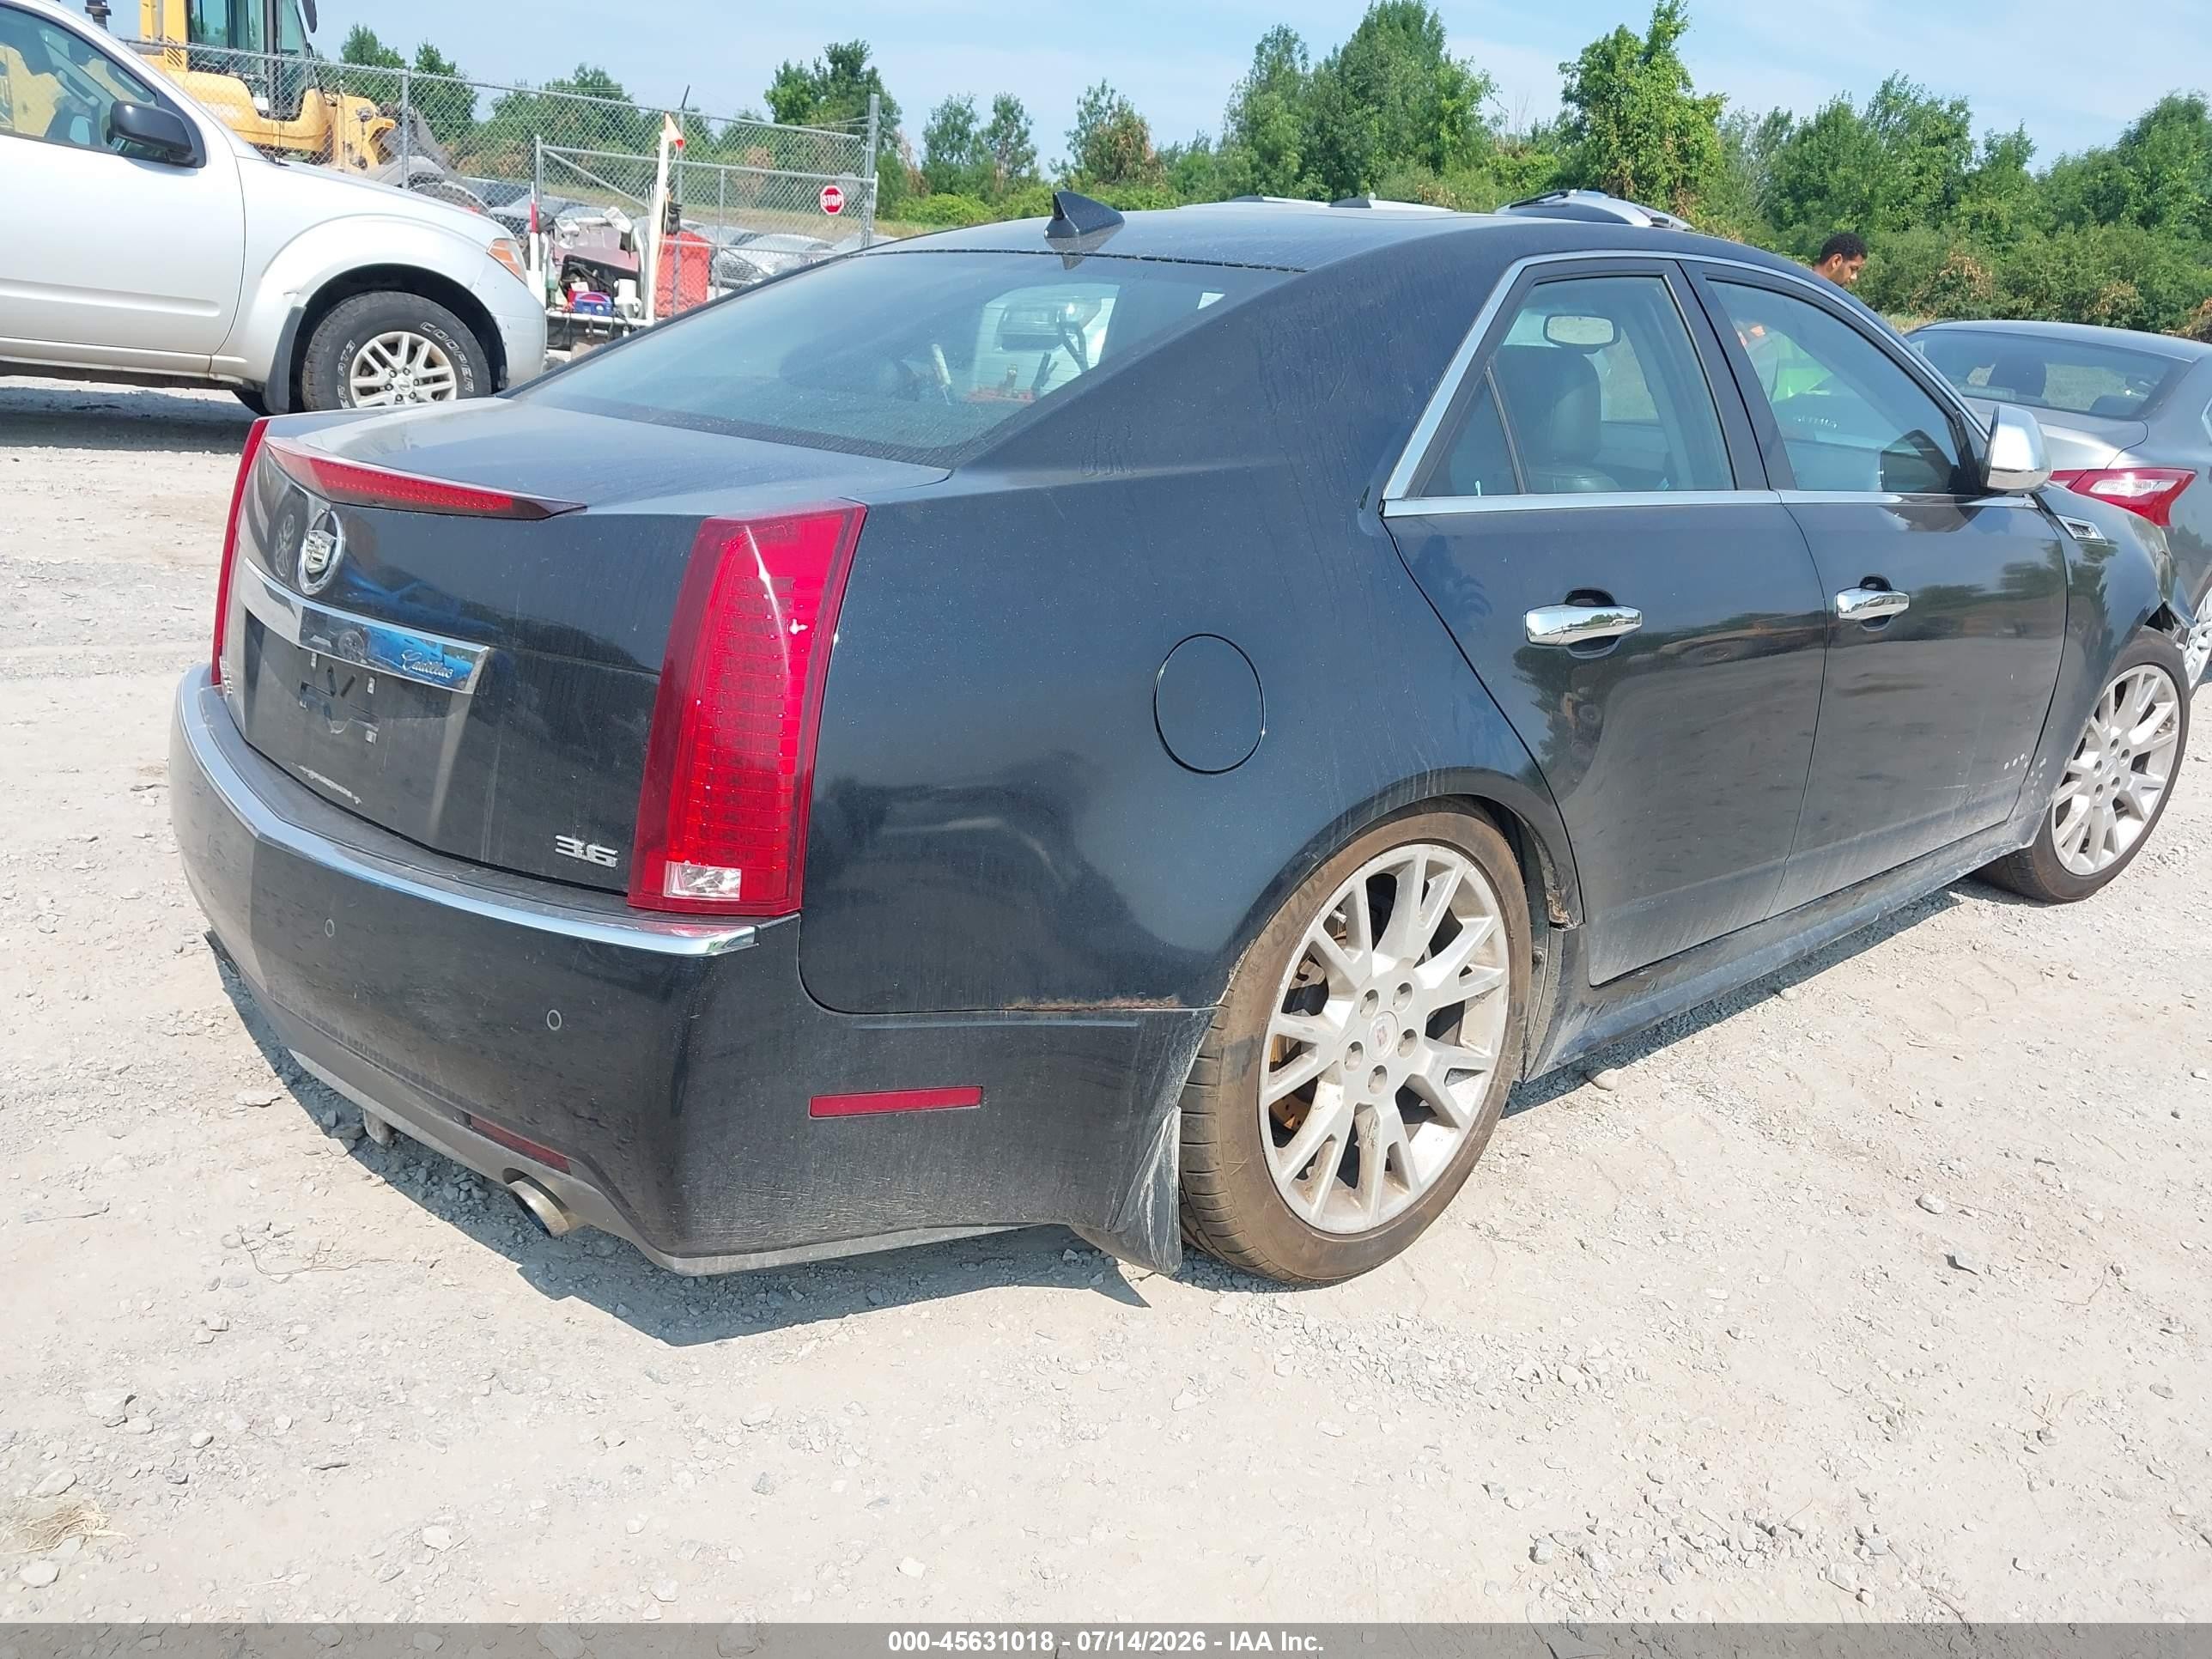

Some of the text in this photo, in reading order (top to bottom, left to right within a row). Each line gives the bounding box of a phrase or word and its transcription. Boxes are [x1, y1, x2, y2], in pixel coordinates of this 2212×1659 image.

[822, 194, 843, 207] STOP
[419, 321, 475, 392] COOPER
[400, 649, 453, 678] Cadillac
